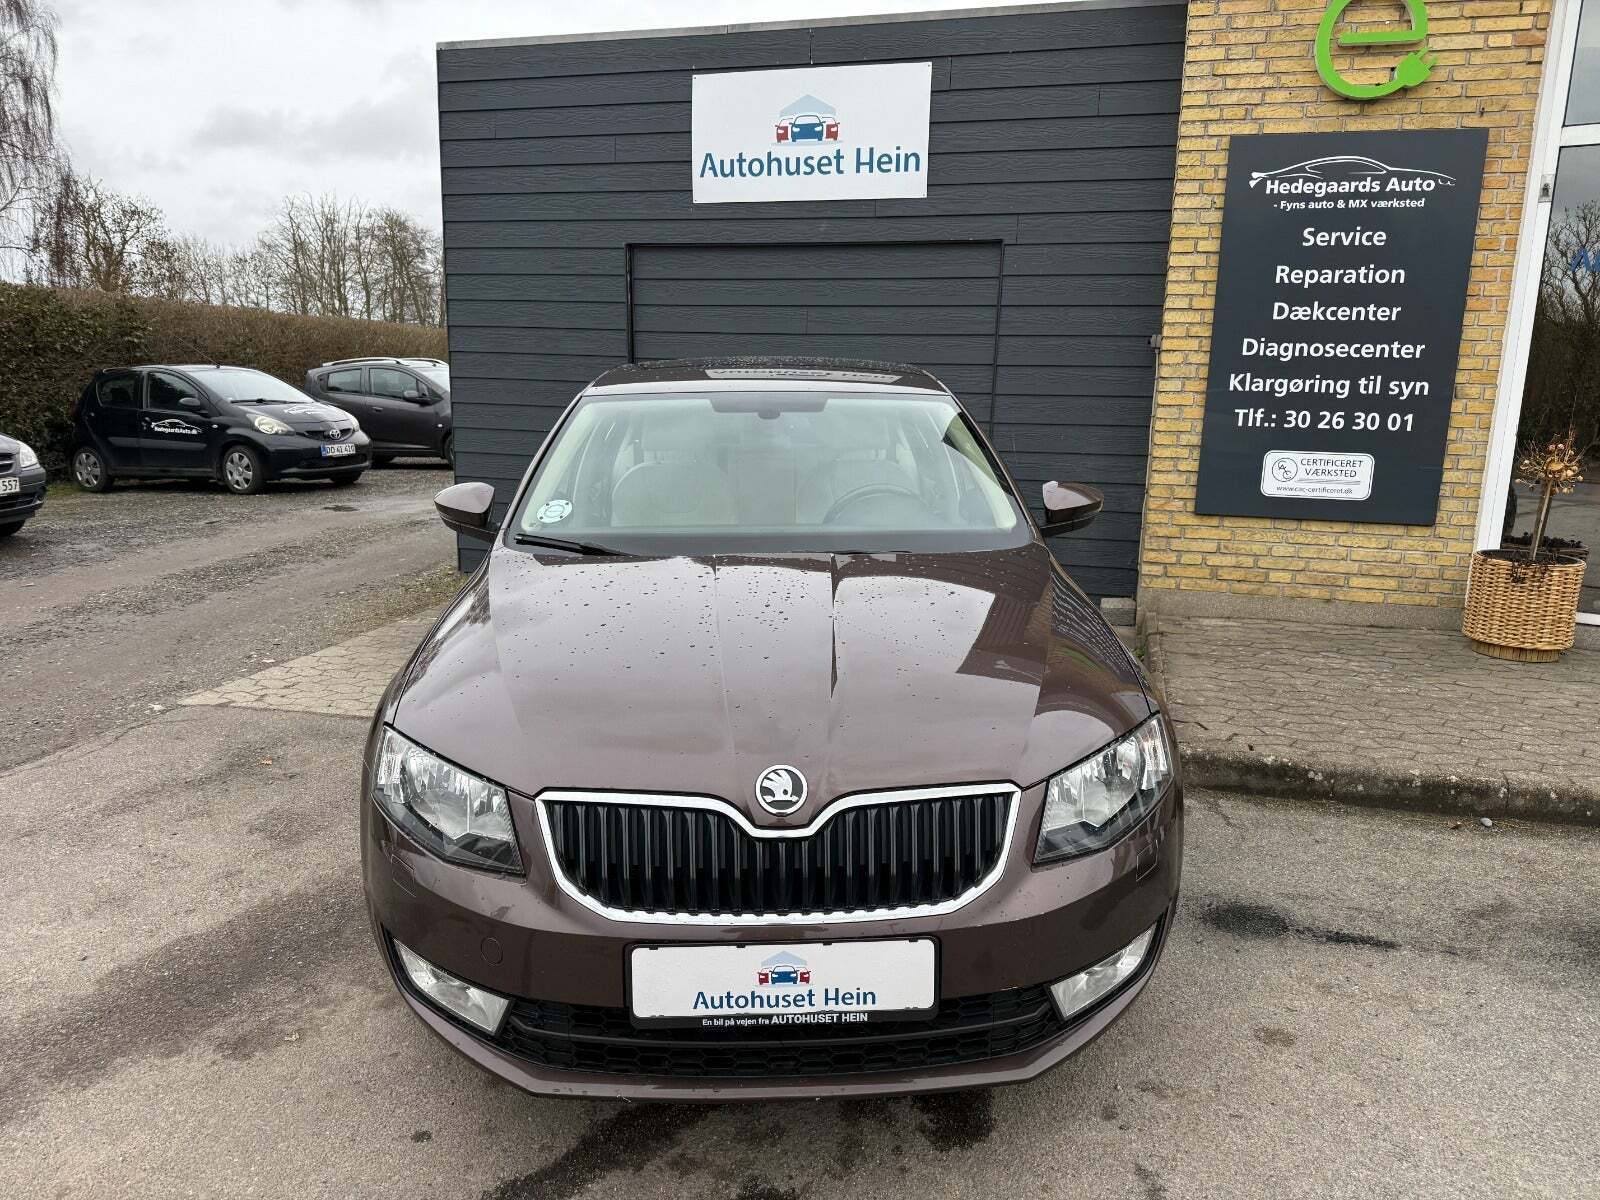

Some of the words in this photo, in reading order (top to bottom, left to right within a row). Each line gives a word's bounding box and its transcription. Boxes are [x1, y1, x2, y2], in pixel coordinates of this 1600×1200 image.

[699, 148, 845, 178] Autohuset
[855, 146, 921, 174] Hein
[1265, 178, 1381, 197] Hedegaards
[1385, 176, 1436, 192] Auto
[1280, 200, 1306, 212] Fyns
[1308, 200, 1335, 209] auto
[1336, 199, 1346, 209] &
[1348, 199, 1368, 209] MX
[1370, 197, 1425, 209] værksted
[1302, 226, 1387, 247] Service
[1275, 264, 1406, 288] Reparation
[1272, 301, 1402, 321] Dækcenter
[1241, 337, 1426, 362] Diagnosecenter
[1228, 373, 1350, 398] Klargøring
[1358, 375, 1382, 395] til
[1388, 380, 1430, 400] syn
[1234, 408, 1277, 427] Tlf.:
[1283, 410, 1311, 429] 30
[1317, 411, 1345, 430] 26
[1352, 412, 1380, 431] 30
[1387, 413, 1414, 432] 01
[1300, 458, 1364, 468] CERTIFICERET
[1304, 468, 1357, 478] VÆRKSTED
[692, 988, 816, 1010] Autohuset
[824, 987, 877, 1006] Hein
[702, 1018, 713, 1026] En
[714, 1018, 725, 1026] bil
[725, 1017, 736, 1027] på
[736, 1017, 757, 1026] vejen
[759, 1017, 770, 1025] fra
[771, 1013, 840, 1025] AUTOHUSET
[842, 1012, 869, 1023] HEIN
